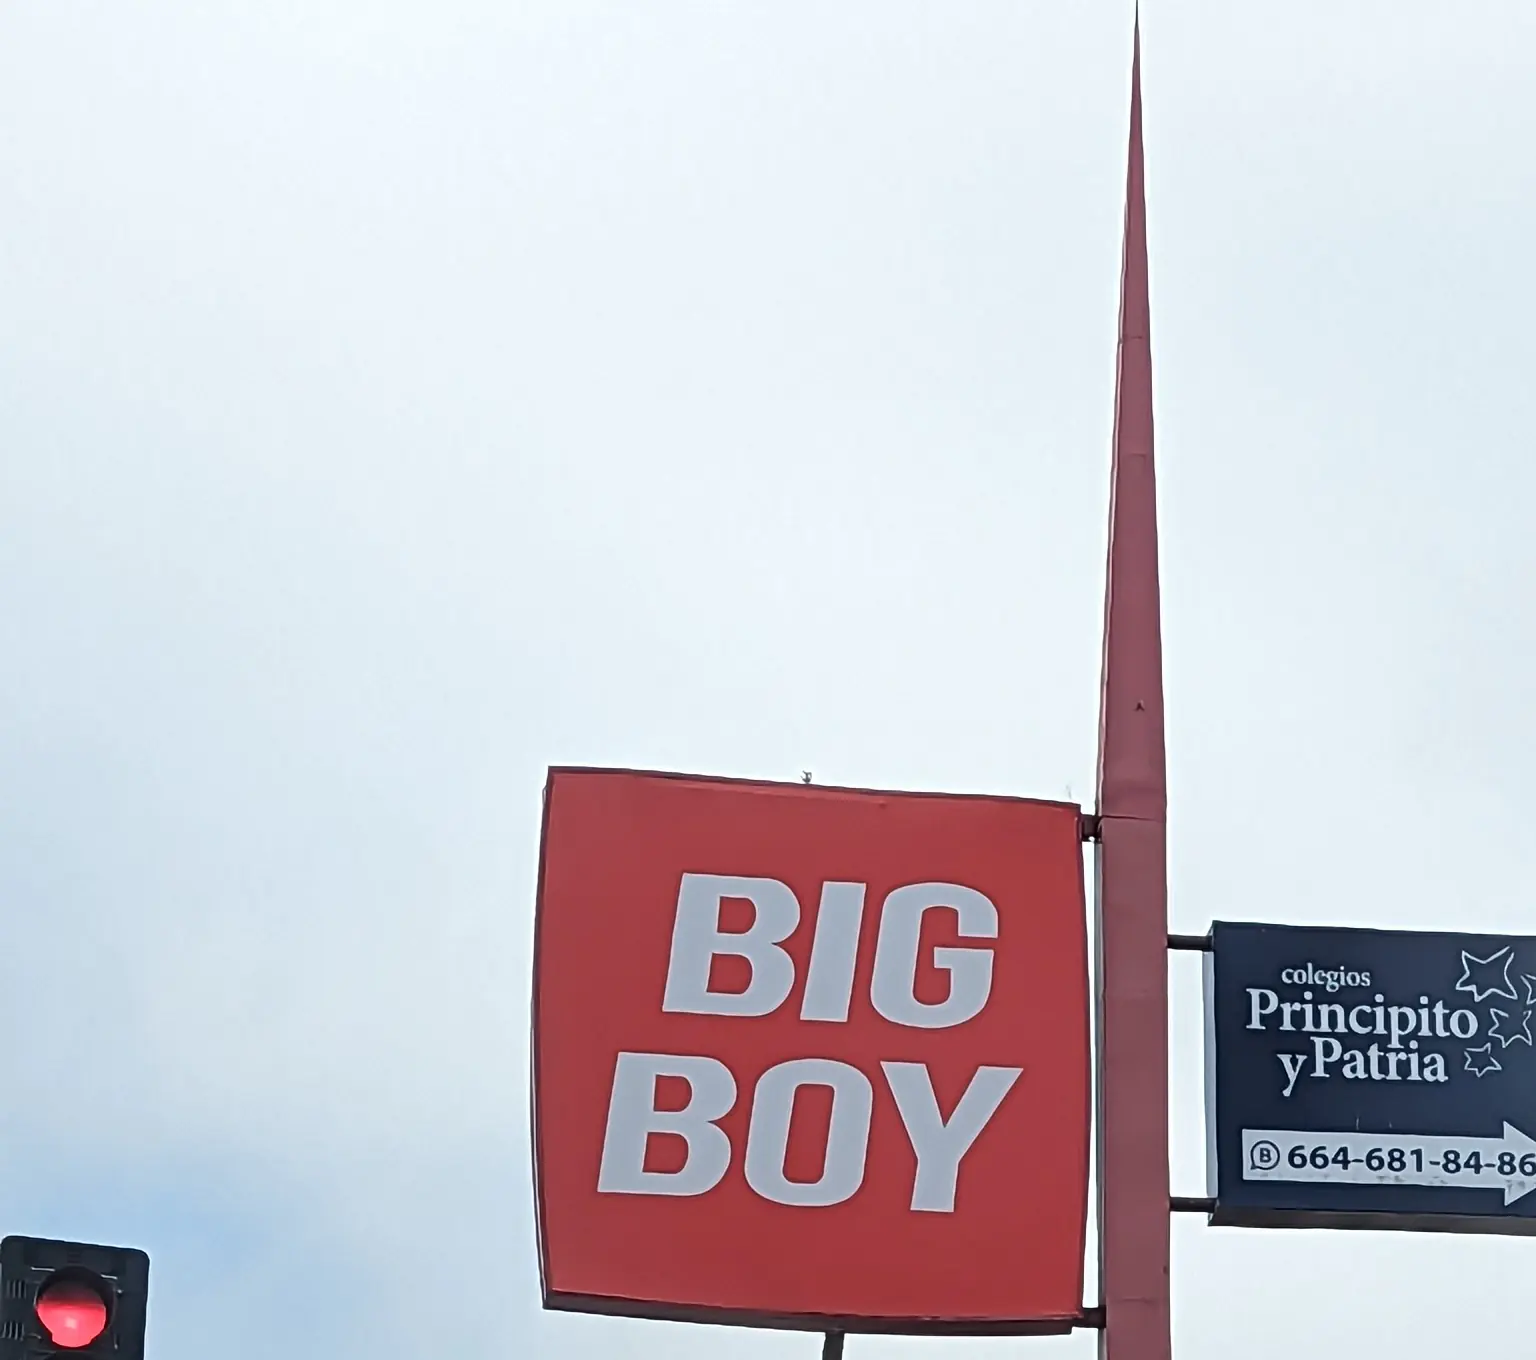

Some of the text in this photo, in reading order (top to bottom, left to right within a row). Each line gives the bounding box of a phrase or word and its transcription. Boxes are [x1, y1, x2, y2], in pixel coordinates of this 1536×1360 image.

[662, 873, 999, 1029] BIG
[1281, 963, 1371, 992] colegios
[1246, 988, 1479, 1049] Principito
[597, 1051, 1024, 1213] BOY
